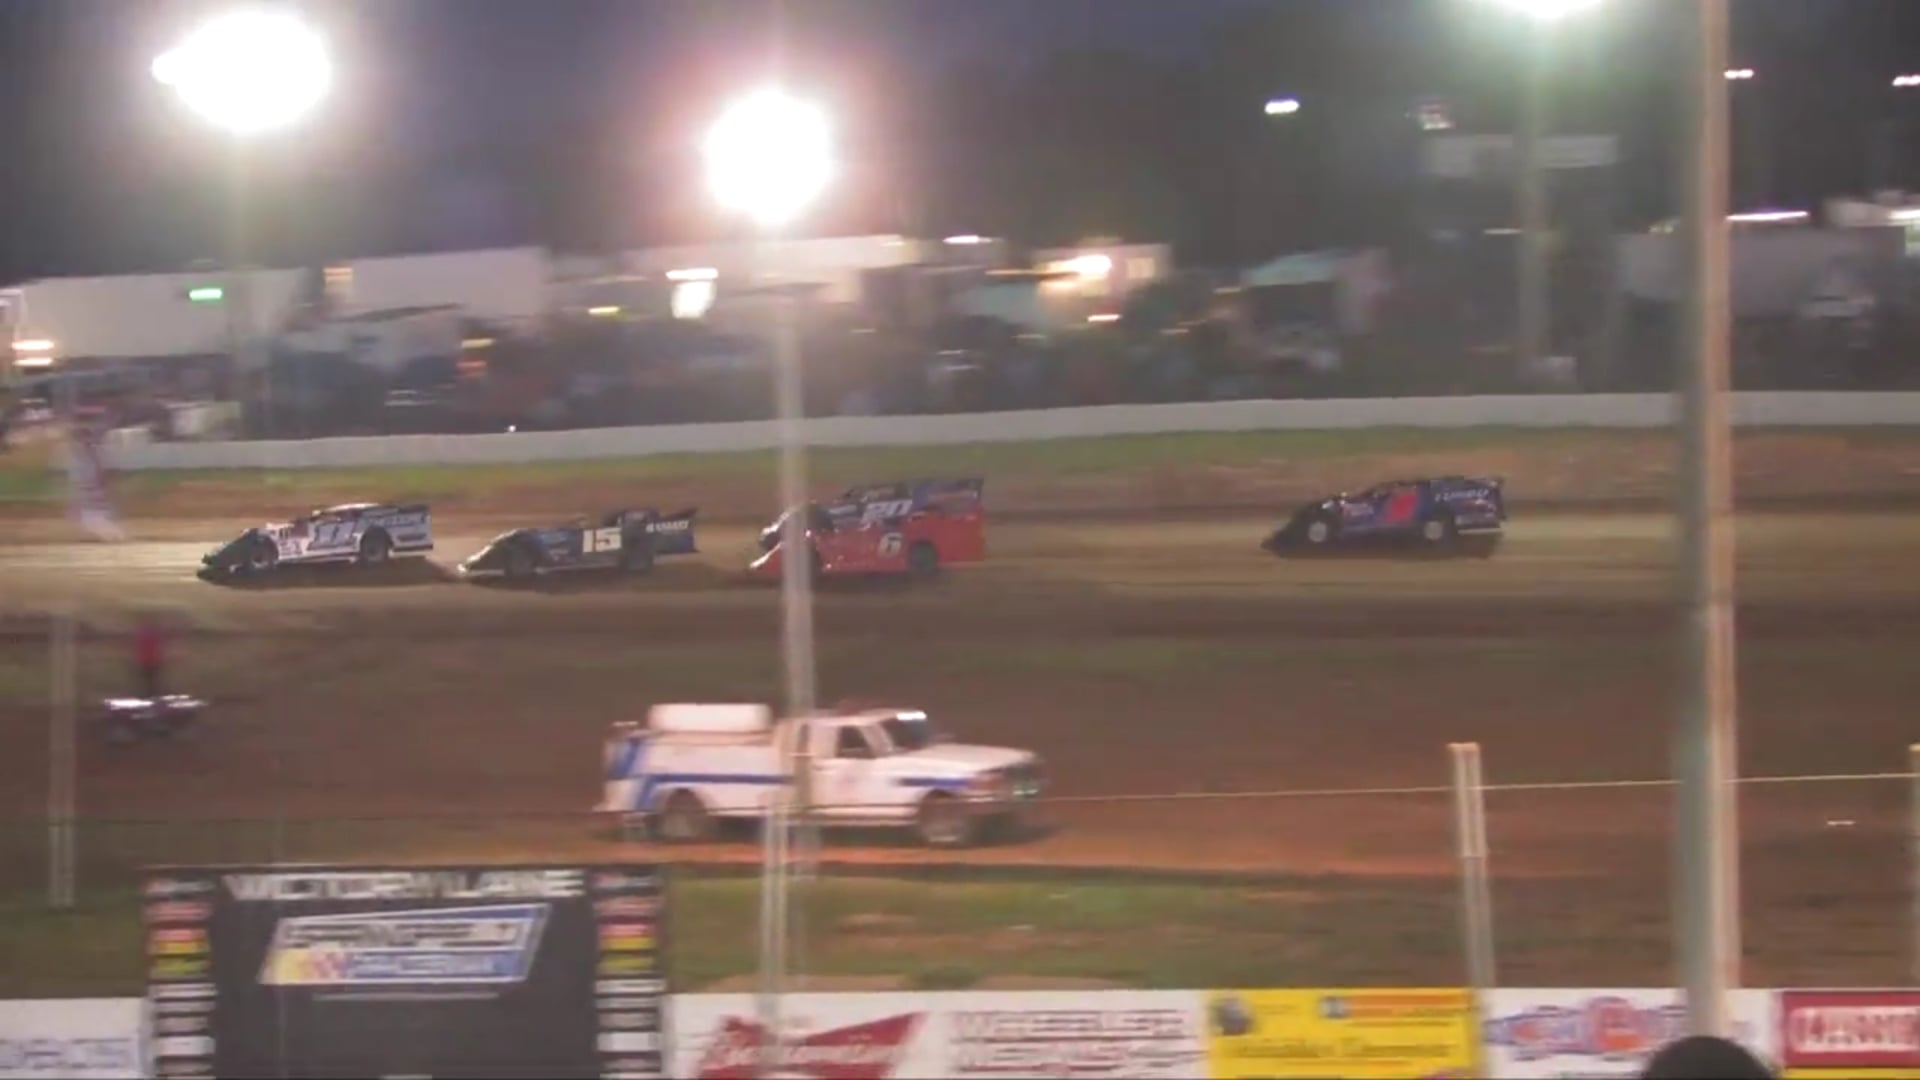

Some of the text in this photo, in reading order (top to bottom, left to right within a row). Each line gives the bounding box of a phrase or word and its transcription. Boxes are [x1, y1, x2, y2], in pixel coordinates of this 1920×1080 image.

[582, 527, 622, 553] 15
[878, 532, 904, 557] 6
[222, 871, 435, 900] VICTORY
[440, 869, 584, 899] LANE
